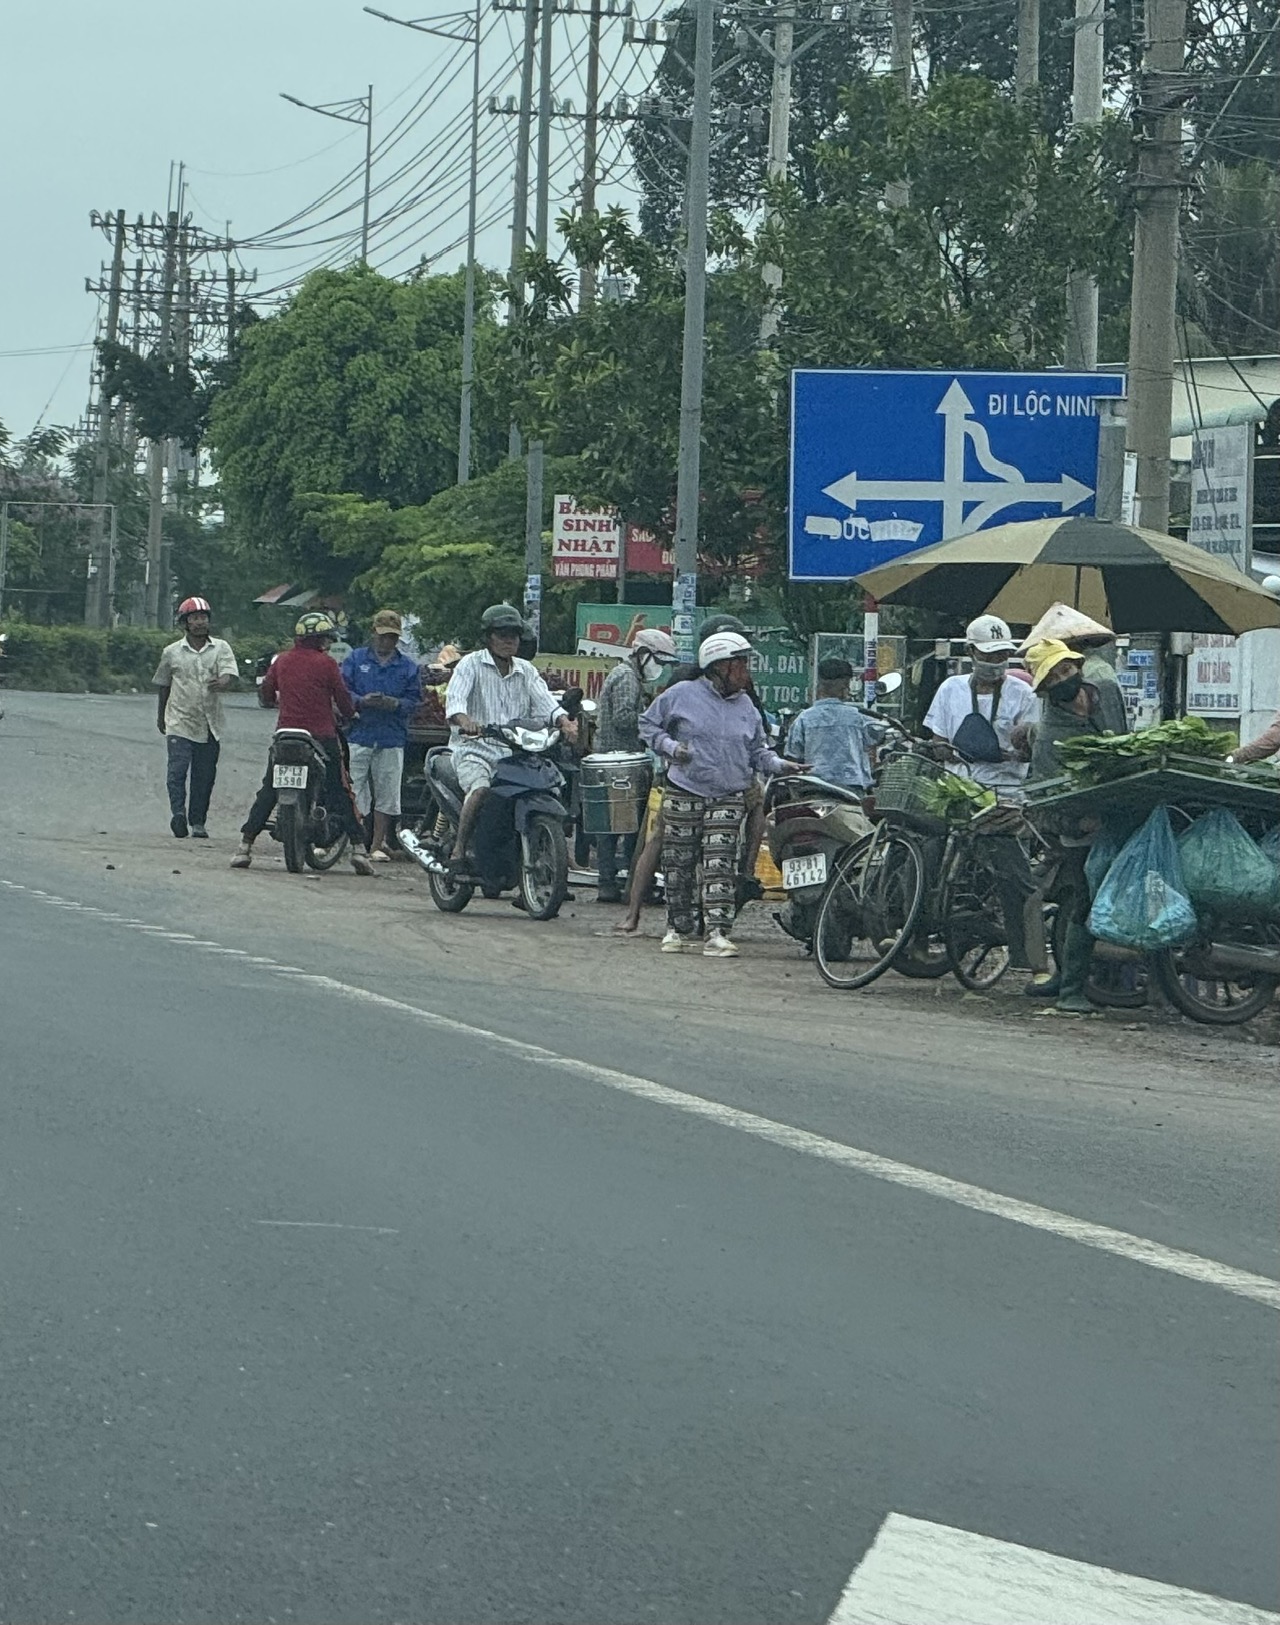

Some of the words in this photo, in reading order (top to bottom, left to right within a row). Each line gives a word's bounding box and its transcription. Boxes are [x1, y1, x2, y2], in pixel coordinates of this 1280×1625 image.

[988, 394, 1008, 416] ĐI
[1013, 389, 1052, 421] LỘC
[562, 518, 612, 532] SINH
[557, 535, 616, 556] NHẬT
